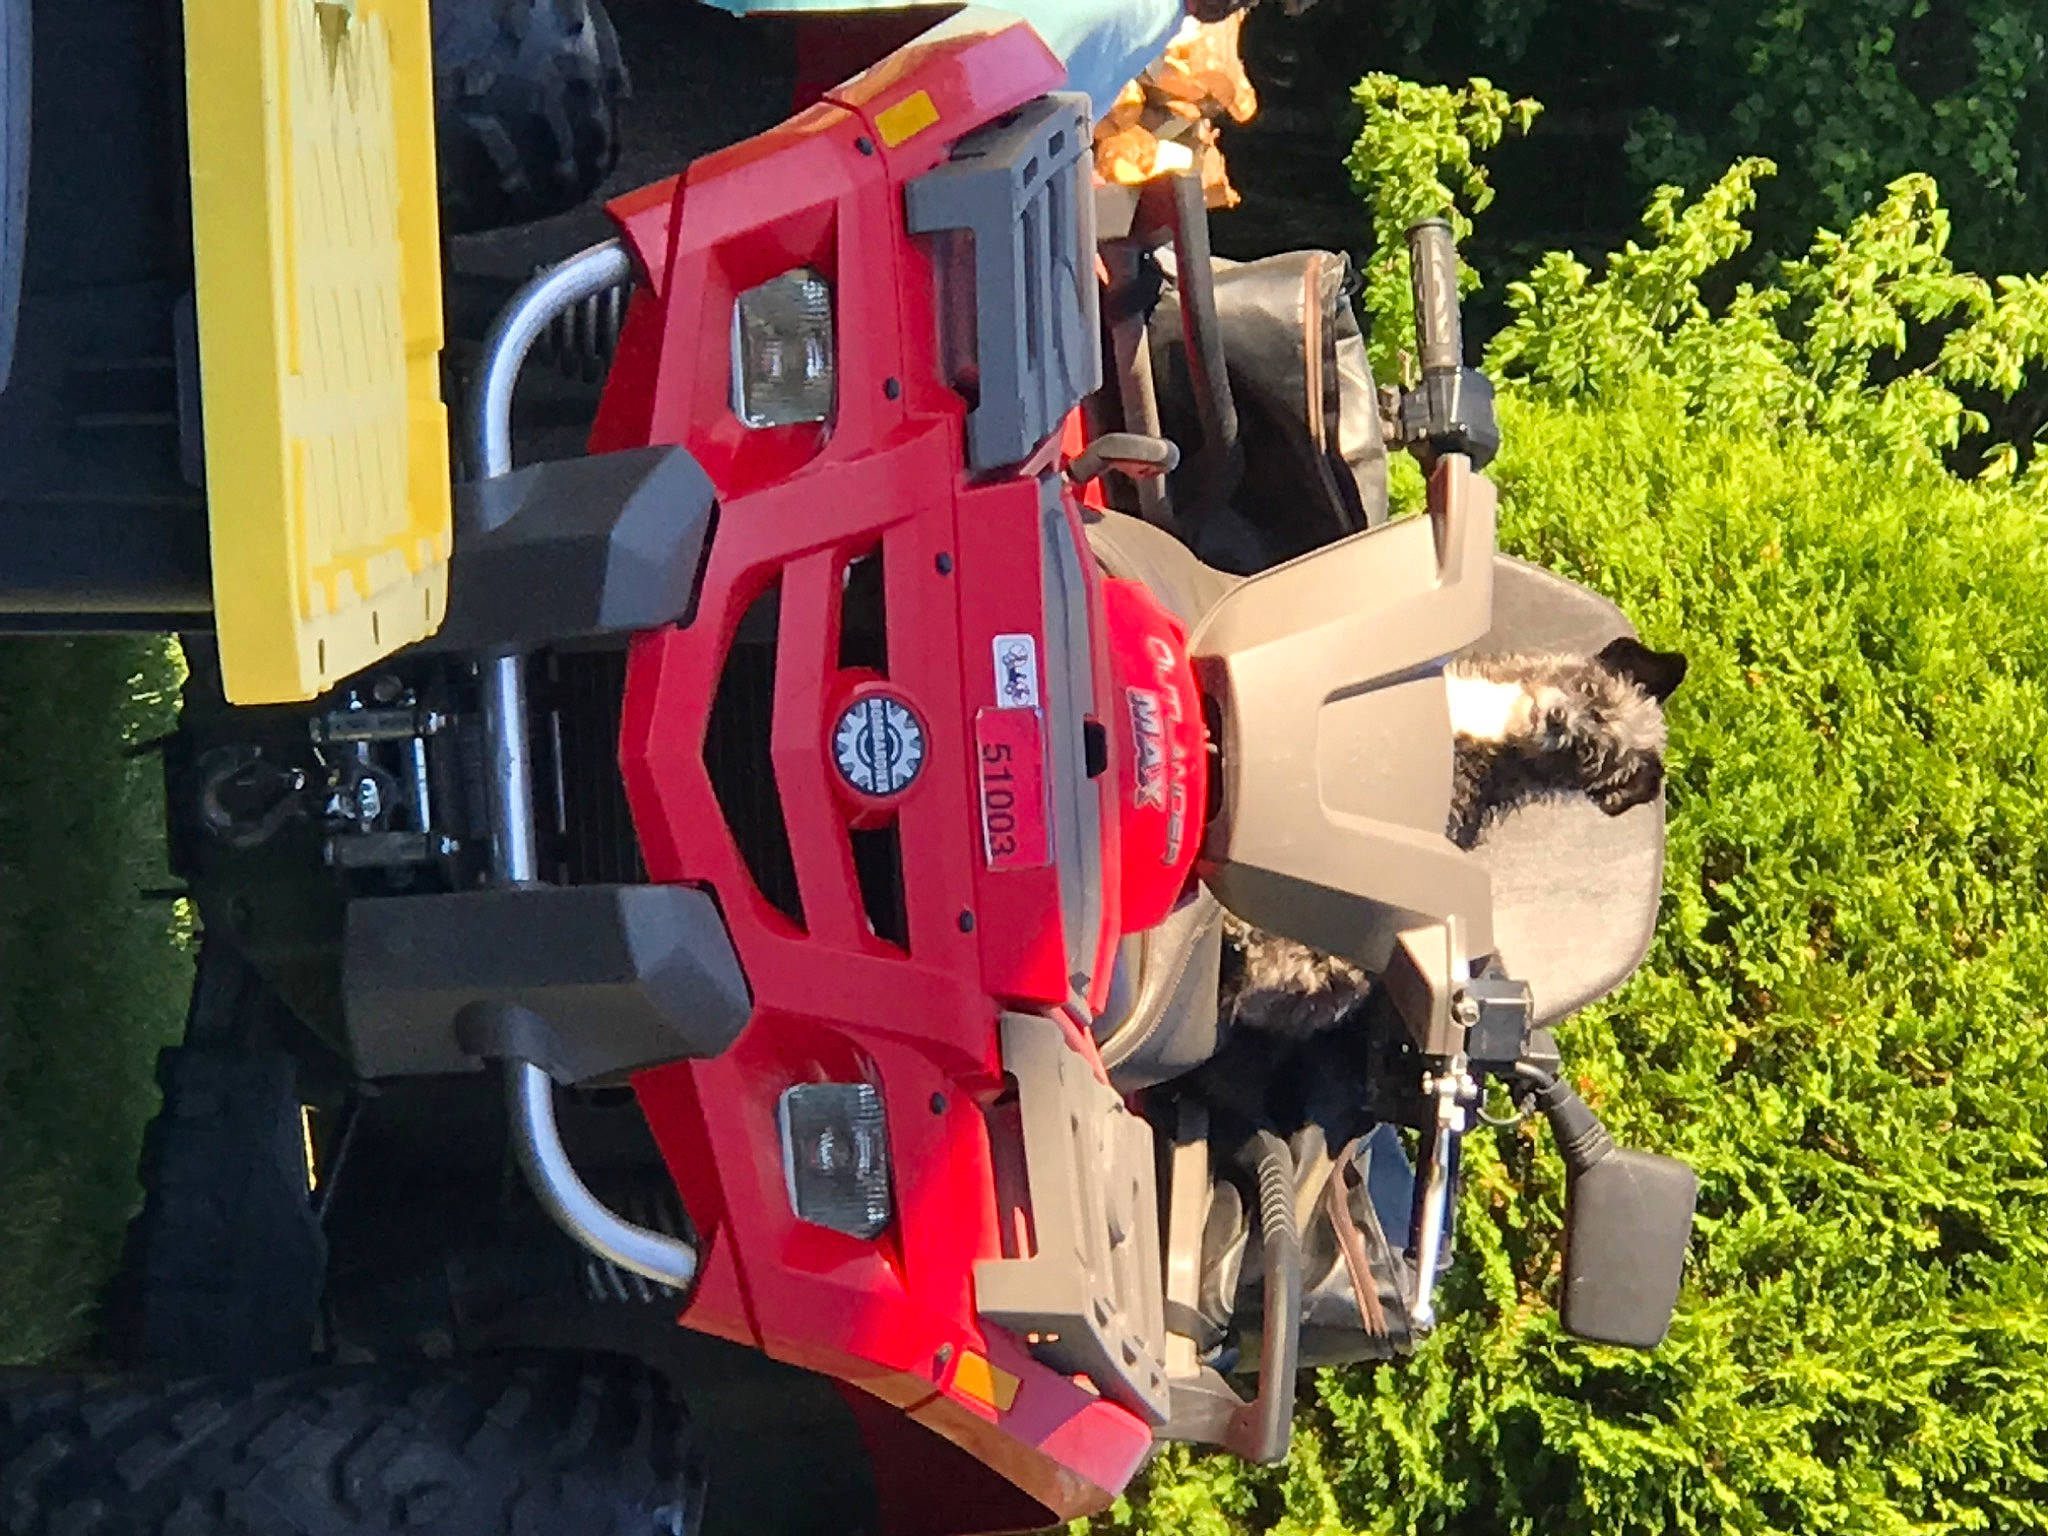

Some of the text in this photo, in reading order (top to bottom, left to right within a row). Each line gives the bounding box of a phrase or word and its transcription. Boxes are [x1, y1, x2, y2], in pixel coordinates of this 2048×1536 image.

[983, 743, 1016, 857] 51003
[1129, 688, 1165, 811] MAX
[1148, 637, 1188, 865] OUTLANDER
